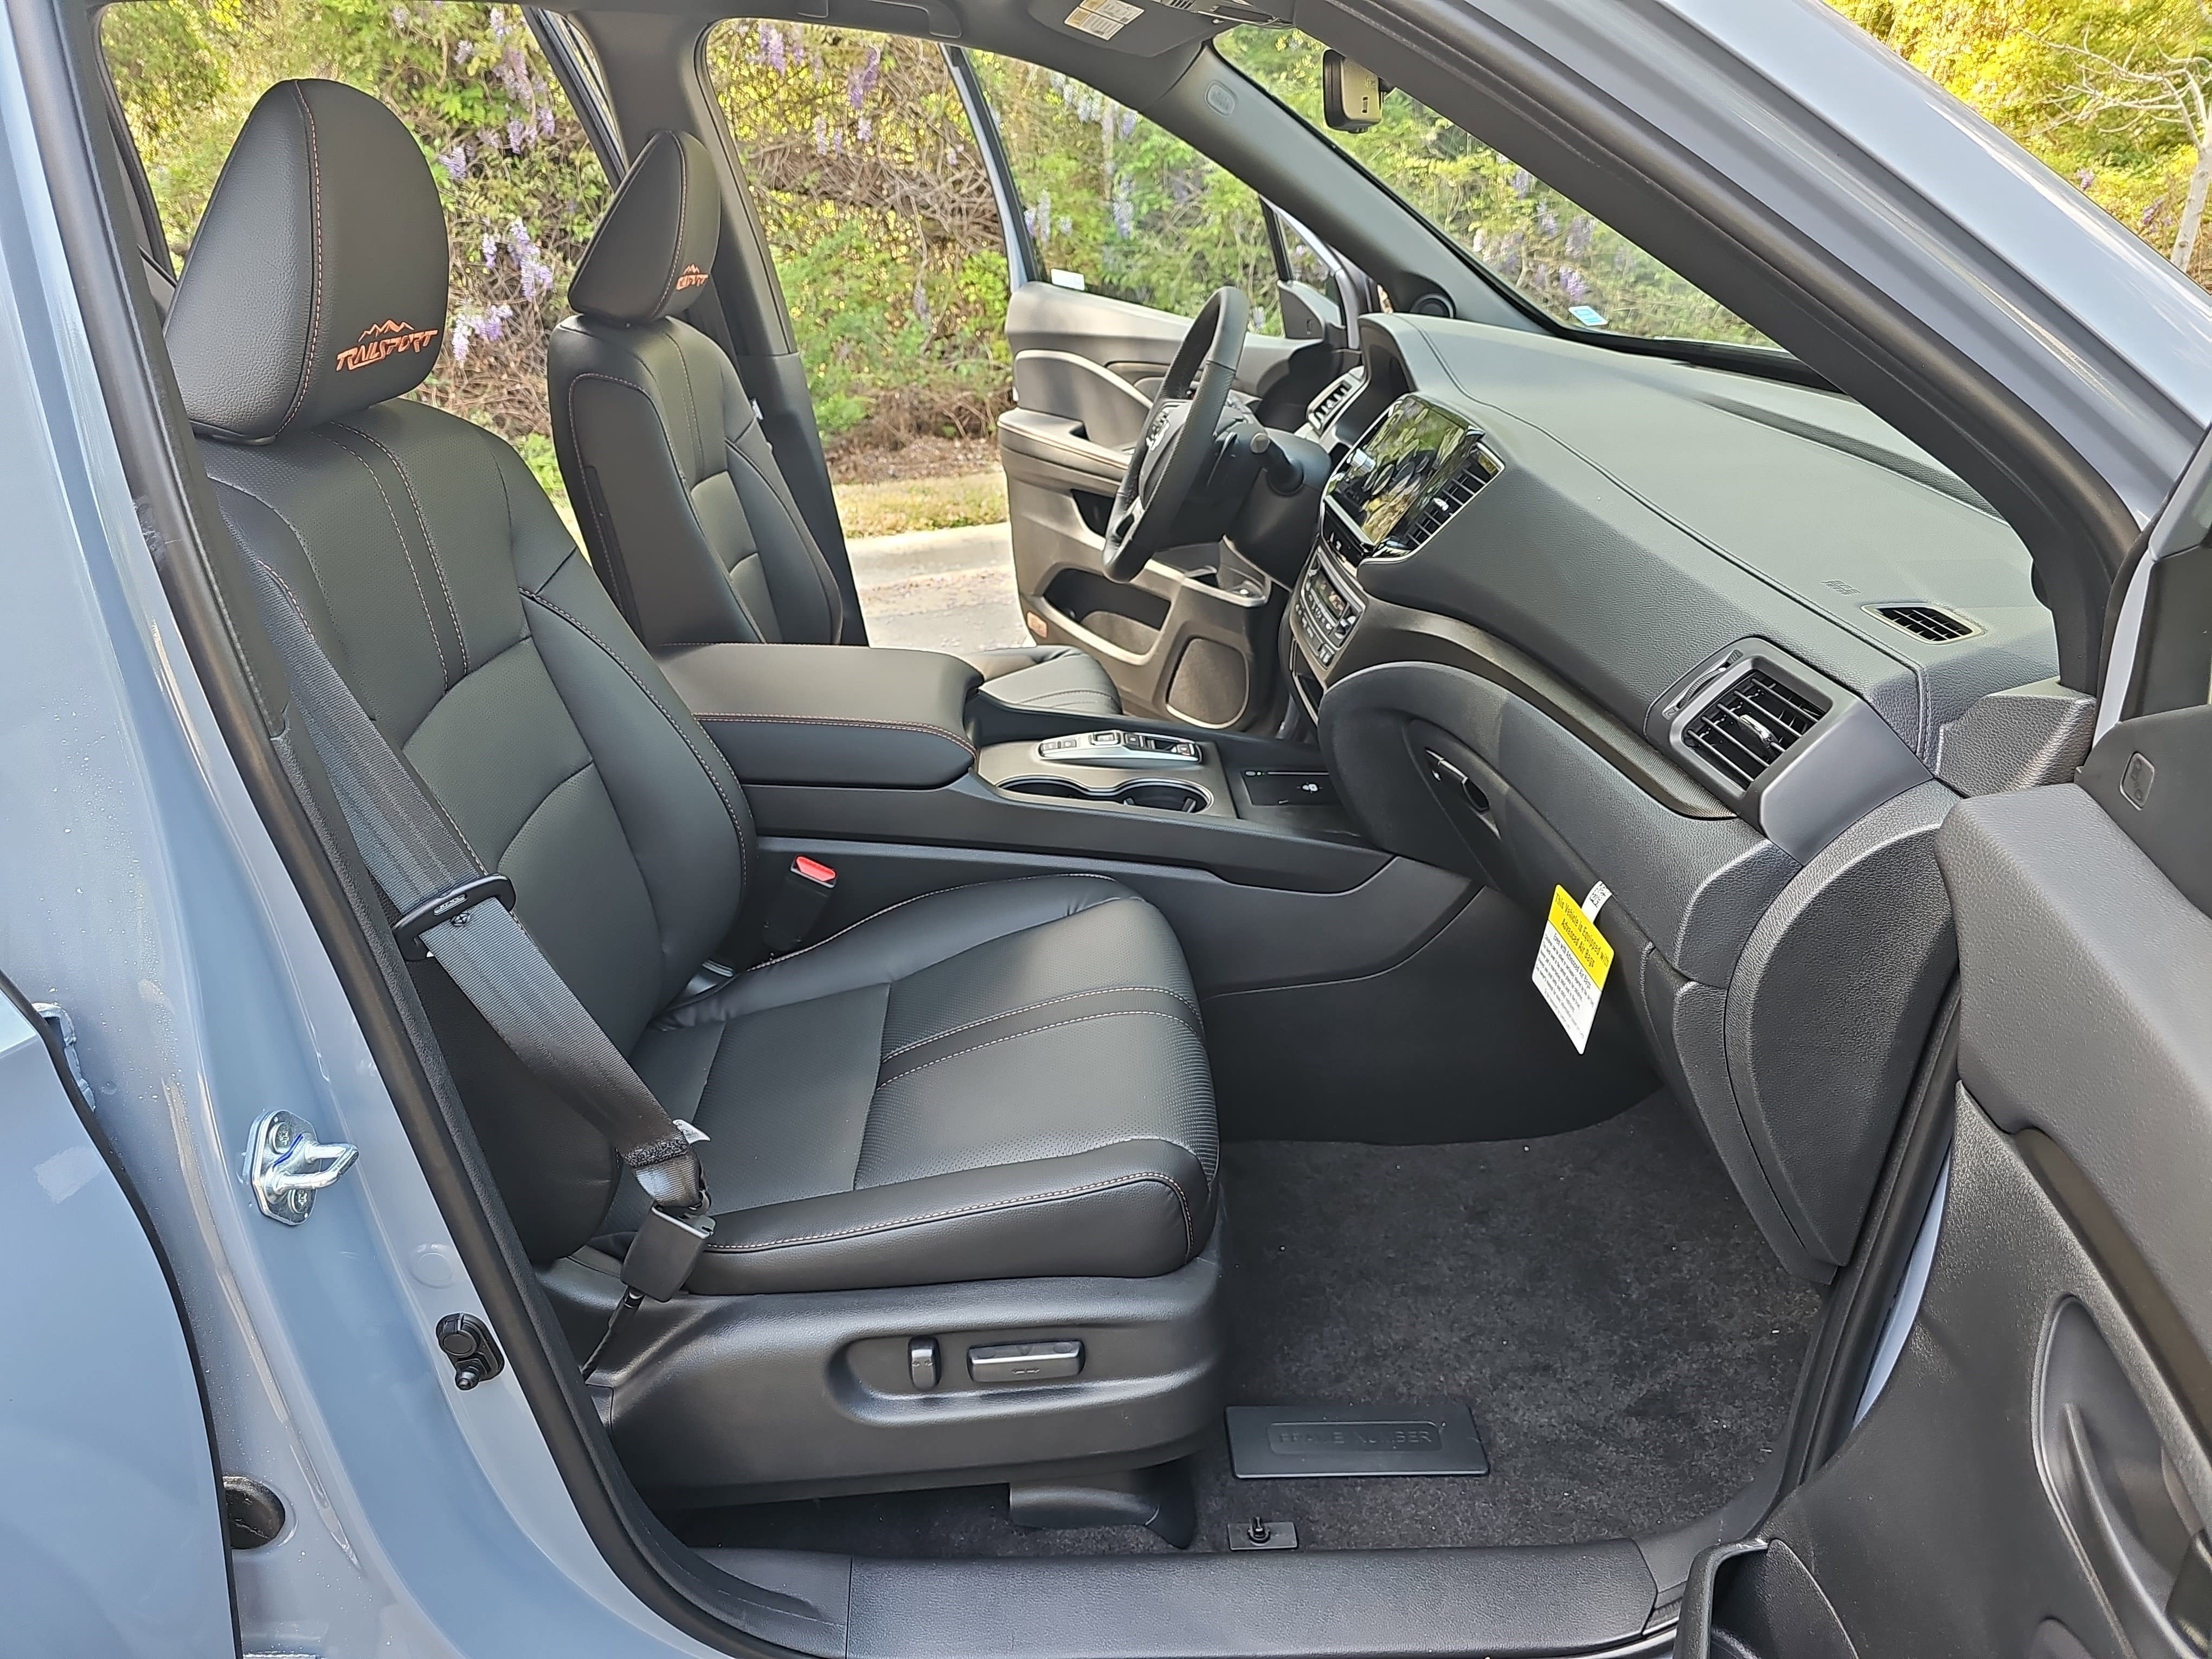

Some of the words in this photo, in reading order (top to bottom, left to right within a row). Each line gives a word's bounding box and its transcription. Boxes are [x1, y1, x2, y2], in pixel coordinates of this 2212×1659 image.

[336, 329, 438, 372] TRAILSPORT
[1555, 893, 1564, 909] This
[1565, 903, 1579, 927] Vehicle
[1578, 921, 1583, 932] is
[1582, 927, 1601, 955] Equipped
[1600, 951, 1609, 968] with
[1561, 918, 1579, 946] Advanced
[1584, 949, 1595, 968] Bags
